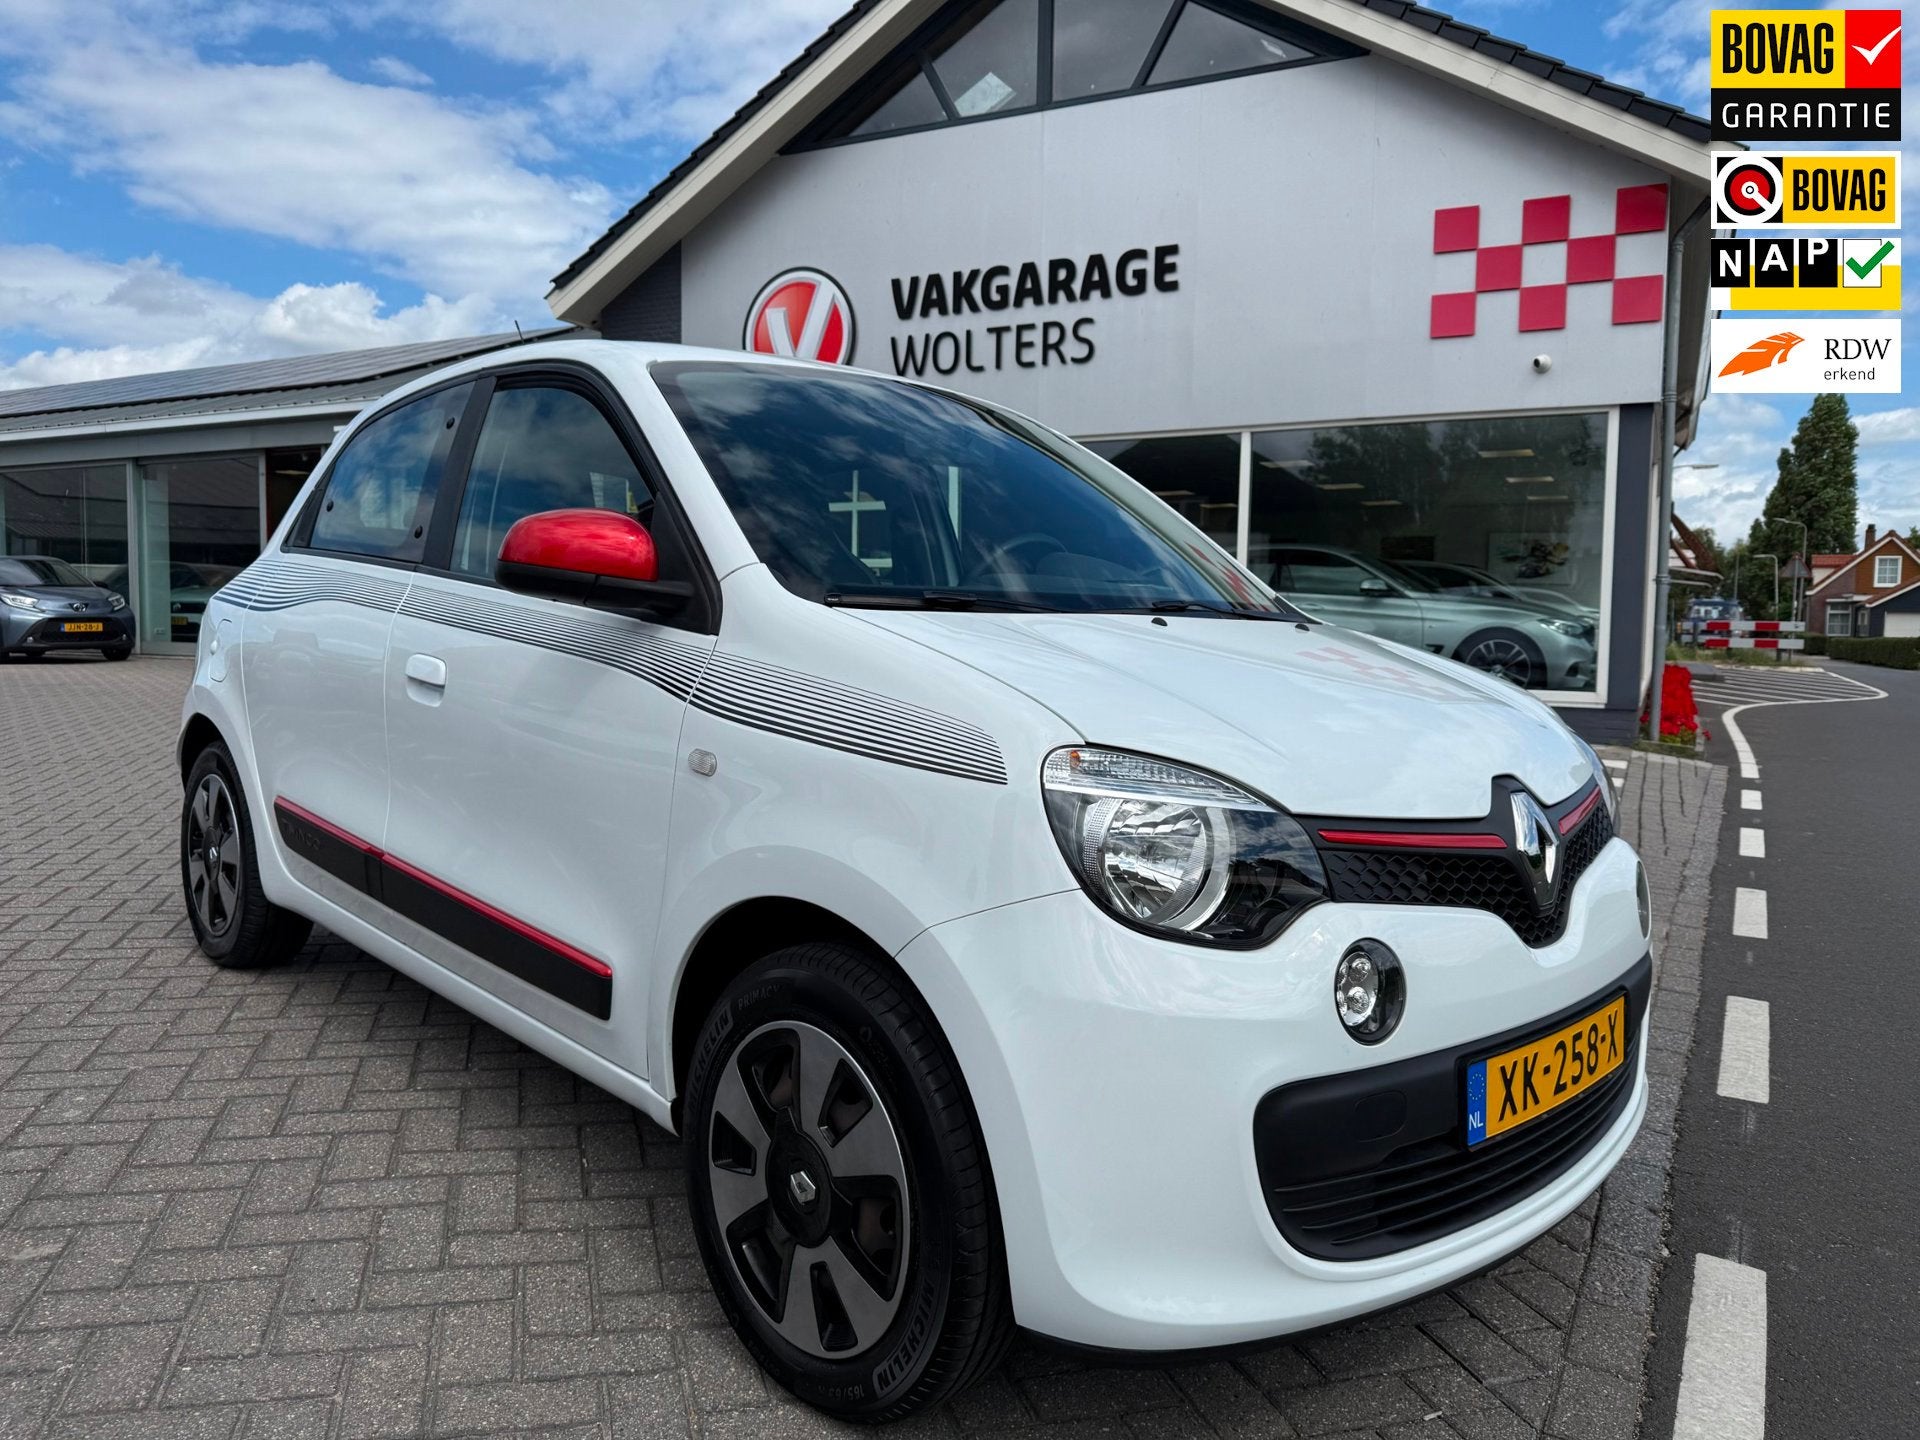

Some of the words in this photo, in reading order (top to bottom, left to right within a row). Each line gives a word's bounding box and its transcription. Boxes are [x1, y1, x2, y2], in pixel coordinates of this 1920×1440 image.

[891, 244, 1179, 320] VAKGARAGE
[890, 317, 1096, 377] WOLTERS
[1498, 1008, 1618, 1123] XK-258-X
[1468, 1111, 1483, 1131] NL
